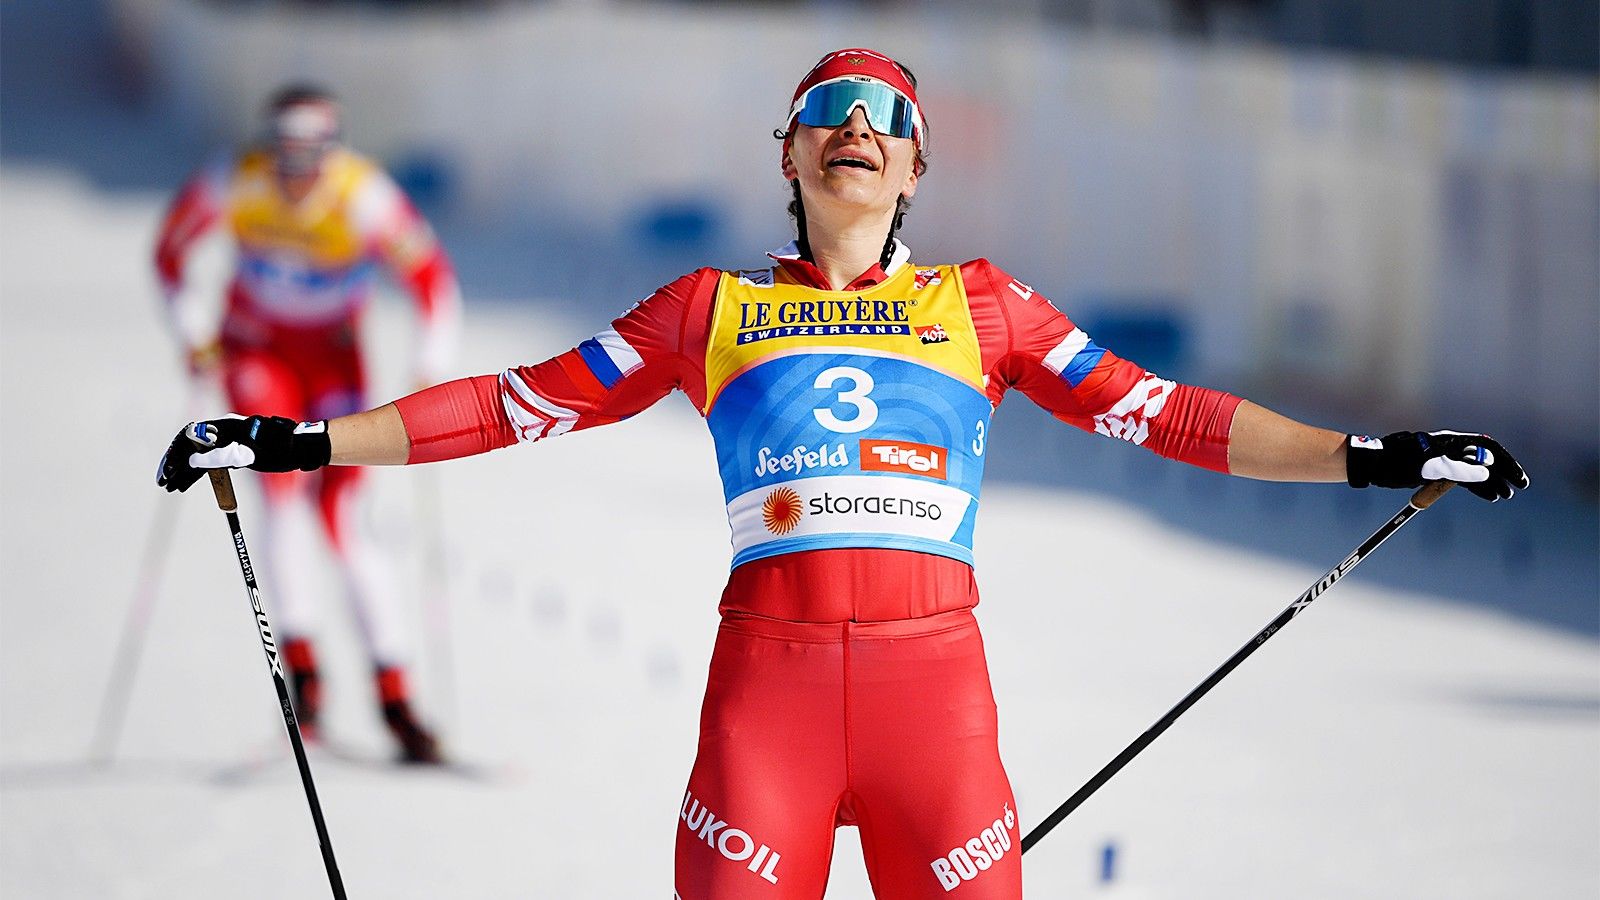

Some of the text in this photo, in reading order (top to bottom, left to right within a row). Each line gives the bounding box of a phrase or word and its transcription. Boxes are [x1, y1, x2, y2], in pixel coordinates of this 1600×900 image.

[740, 302, 771, 329] LE
[744, 325, 902, 342] SWITZERLAND
[813, 366, 879, 433] 3
[972, 419, 985, 457] 3
[755, 443, 939, 477] Seefeld Tirol
[680, 791, 782, 885] LUKOIL
[930, 818, 1013, 892] BOSCO
